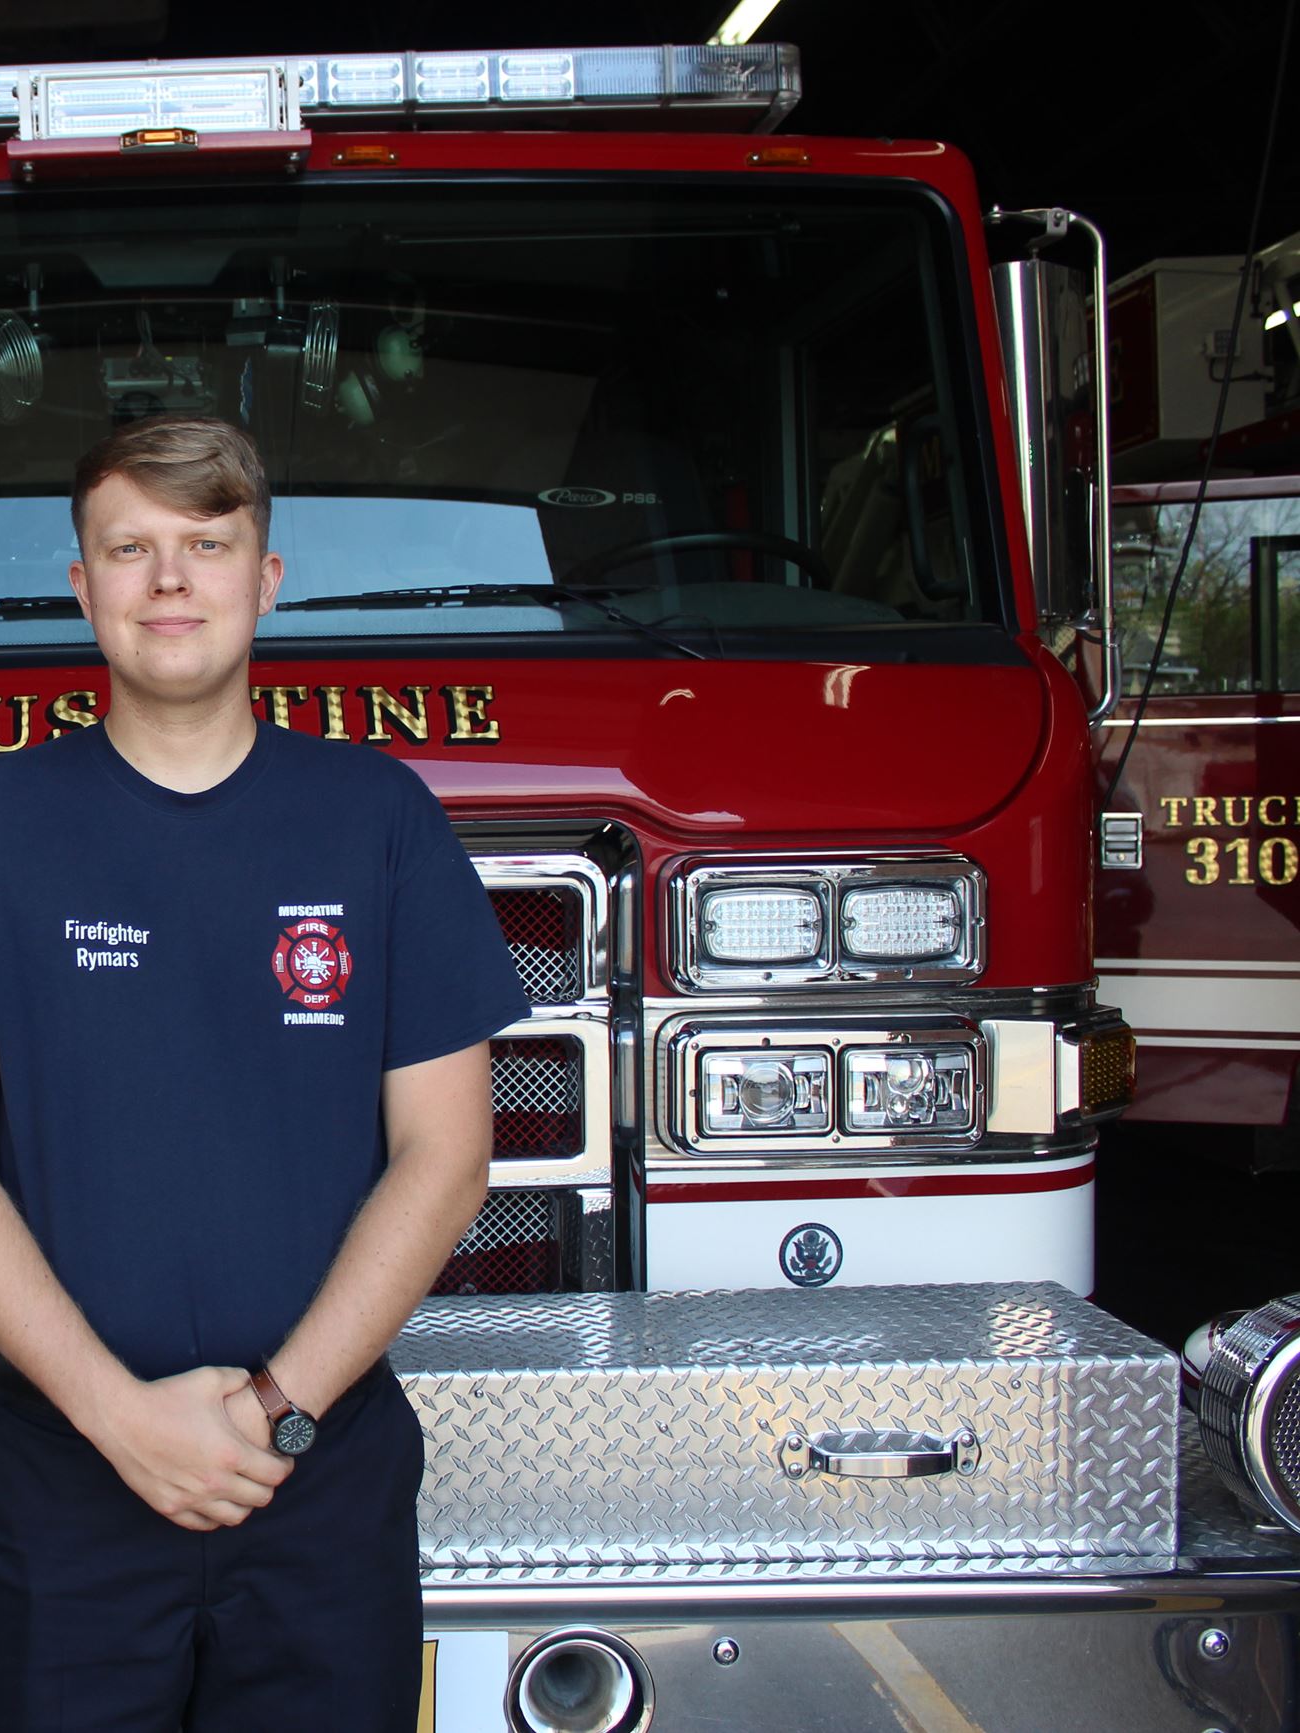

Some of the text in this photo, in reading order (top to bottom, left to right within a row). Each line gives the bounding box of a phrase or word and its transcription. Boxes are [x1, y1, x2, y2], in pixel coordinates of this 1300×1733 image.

[1160, 796, 1300, 827] TRUC
[1185, 837, 1300, 885] 310
[278, 904, 344, 917] MUSCATINE
[65, 919, 150, 946] Firefighter
[297, 922, 329, 935] FIRE
[76, 947, 139, 972] Rymars
[303, 994, 330, 1005] DEPT
[283, 1012, 345, 1026] PARAMEDIC
